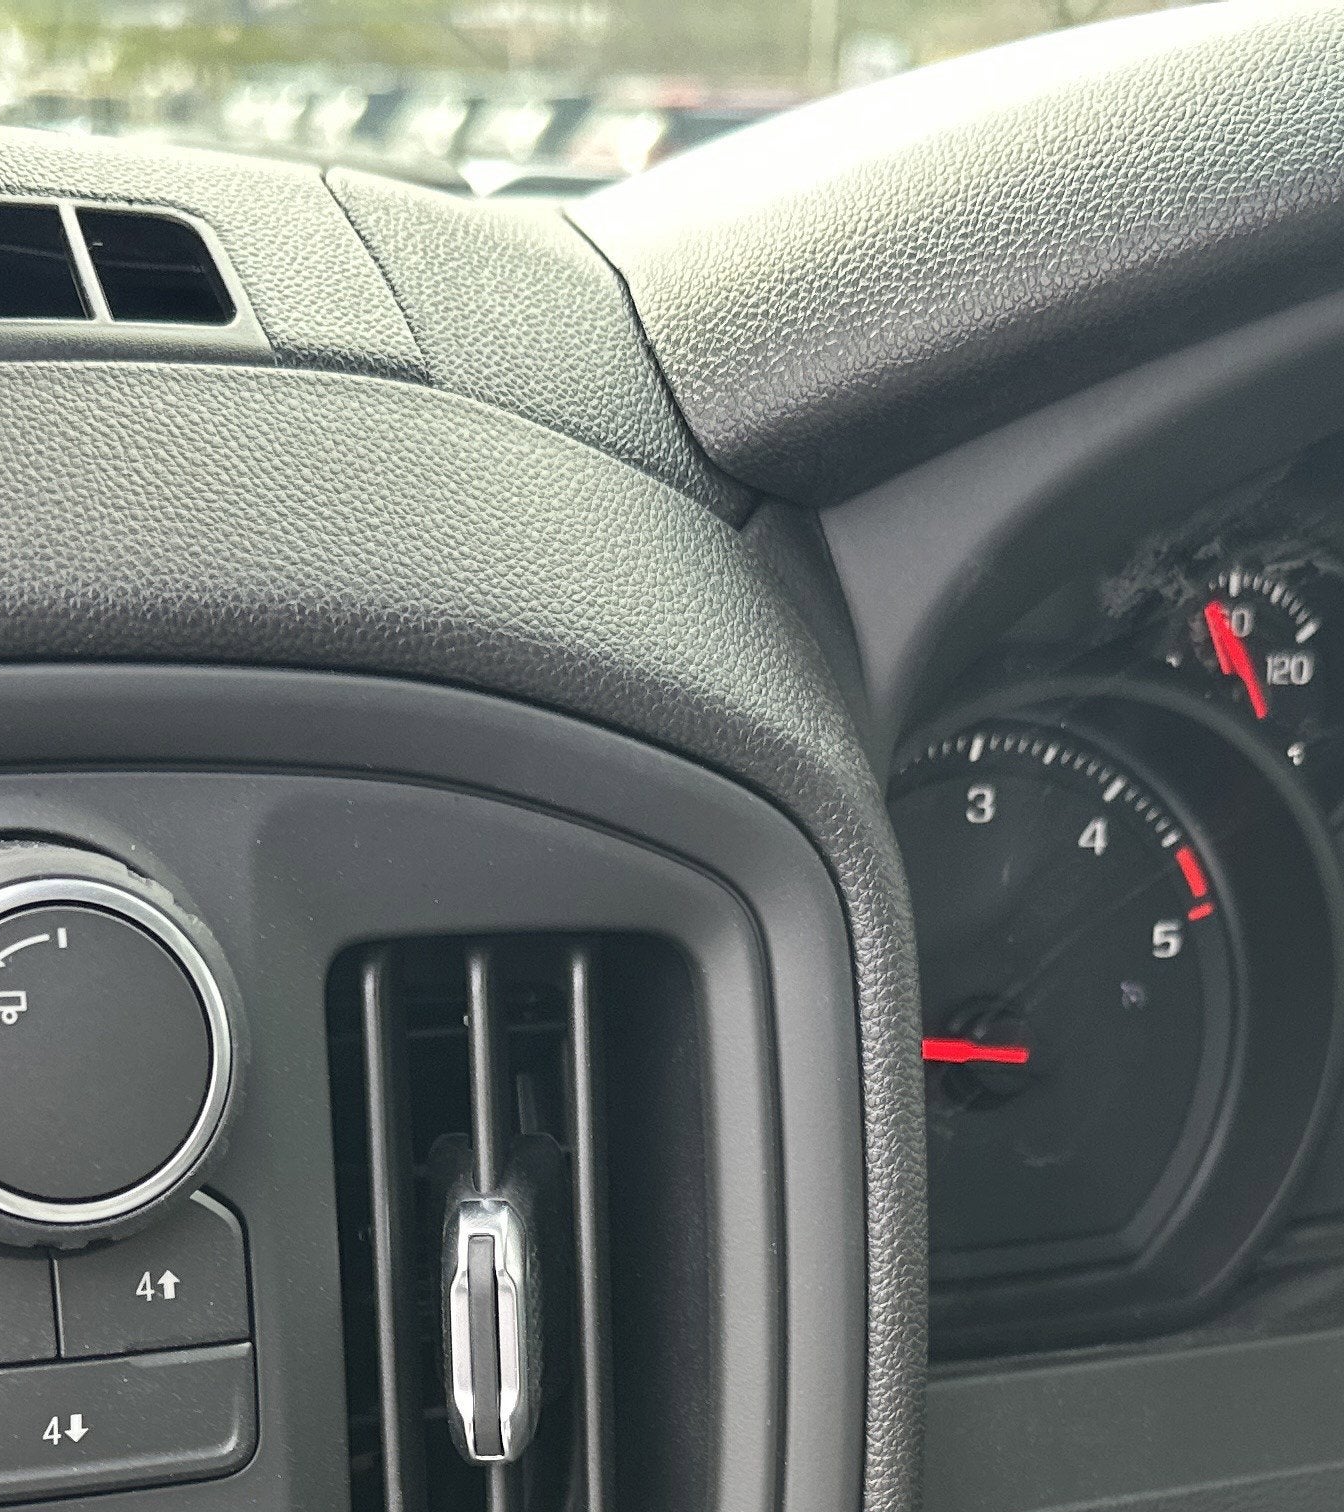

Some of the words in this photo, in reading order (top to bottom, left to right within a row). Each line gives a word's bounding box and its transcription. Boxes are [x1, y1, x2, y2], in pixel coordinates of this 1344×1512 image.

[1266, 650, 1315, 686] 120
[965, 783, 997, 824] 3
[1077, 816, 1108, 856] 4
[1152, 918, 1183, 958] 5
[134, 1270, 155, 1302] 4
[41, 1416, 62, 1447] 4
